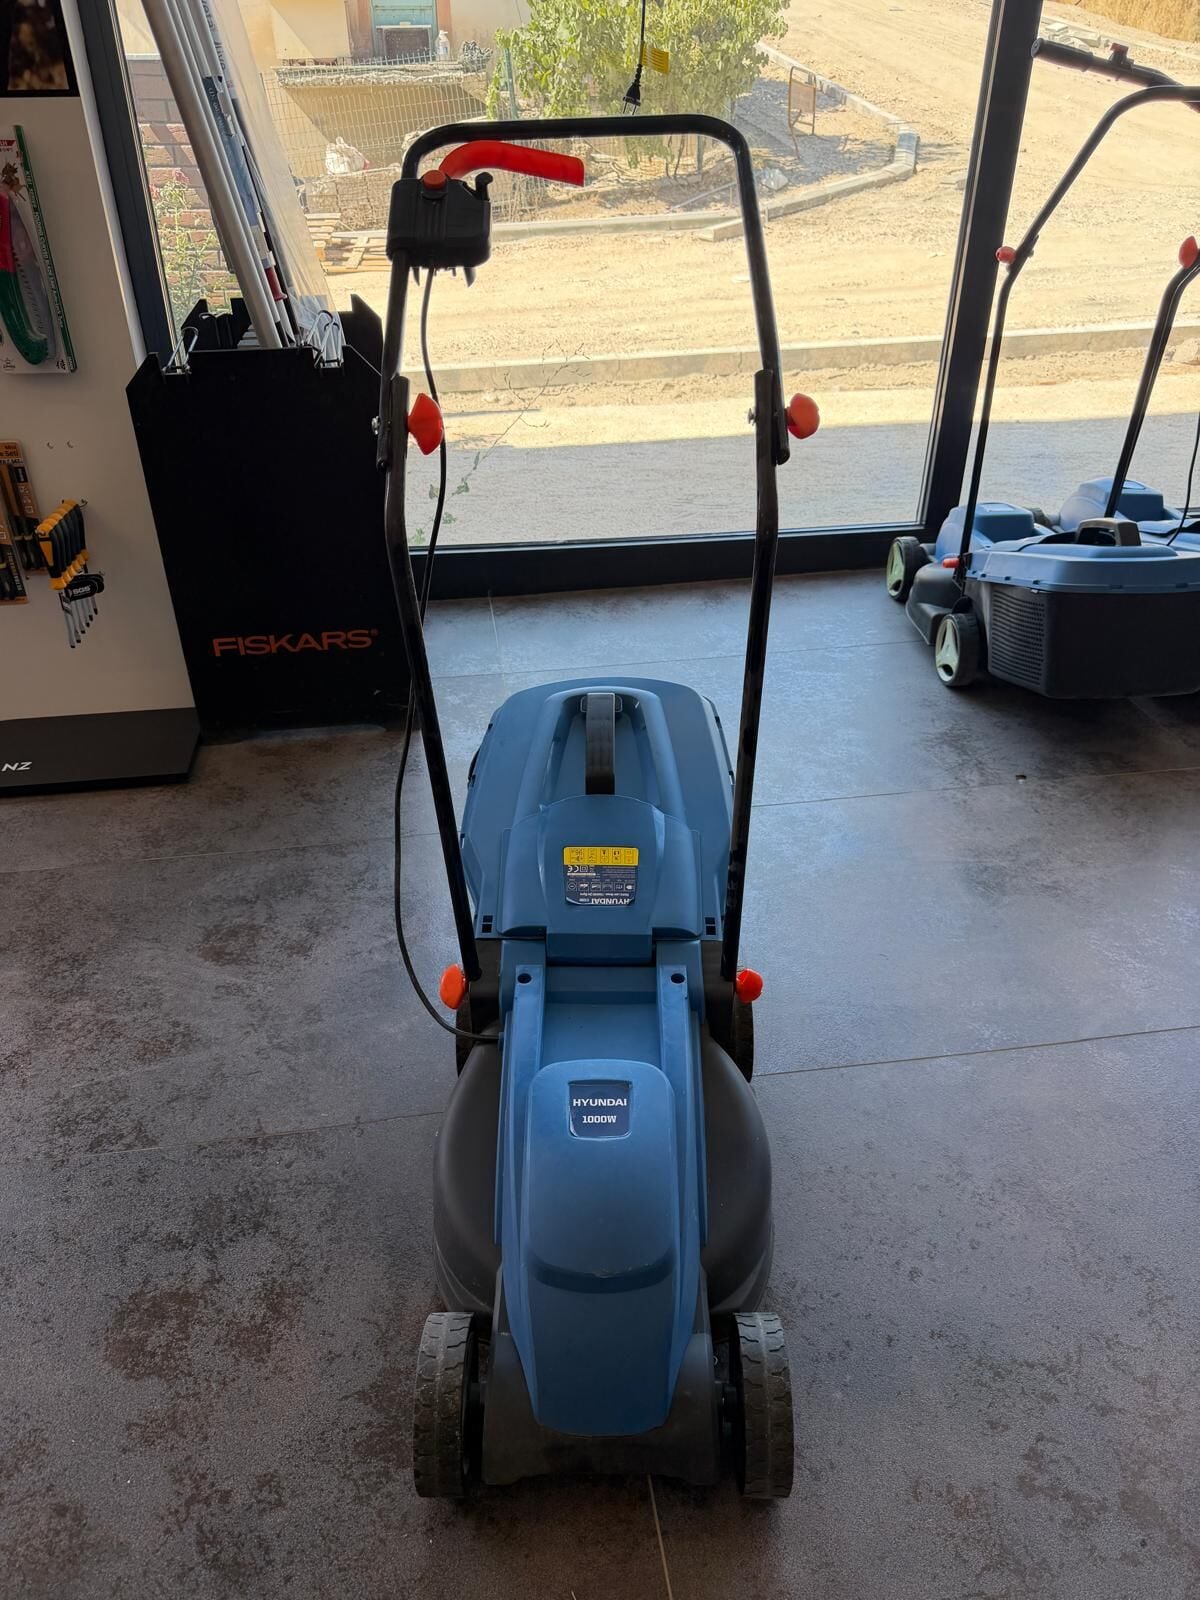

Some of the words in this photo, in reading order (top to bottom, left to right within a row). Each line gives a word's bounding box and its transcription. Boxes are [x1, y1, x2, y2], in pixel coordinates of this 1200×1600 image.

[212, 629, 374, 657] FISKARS
[591, 897, 630, 905] HYUNDAI
[572, 1098, 627, 1107] HYUNDAI
[582, 1115, 617, 1124] 1000W
